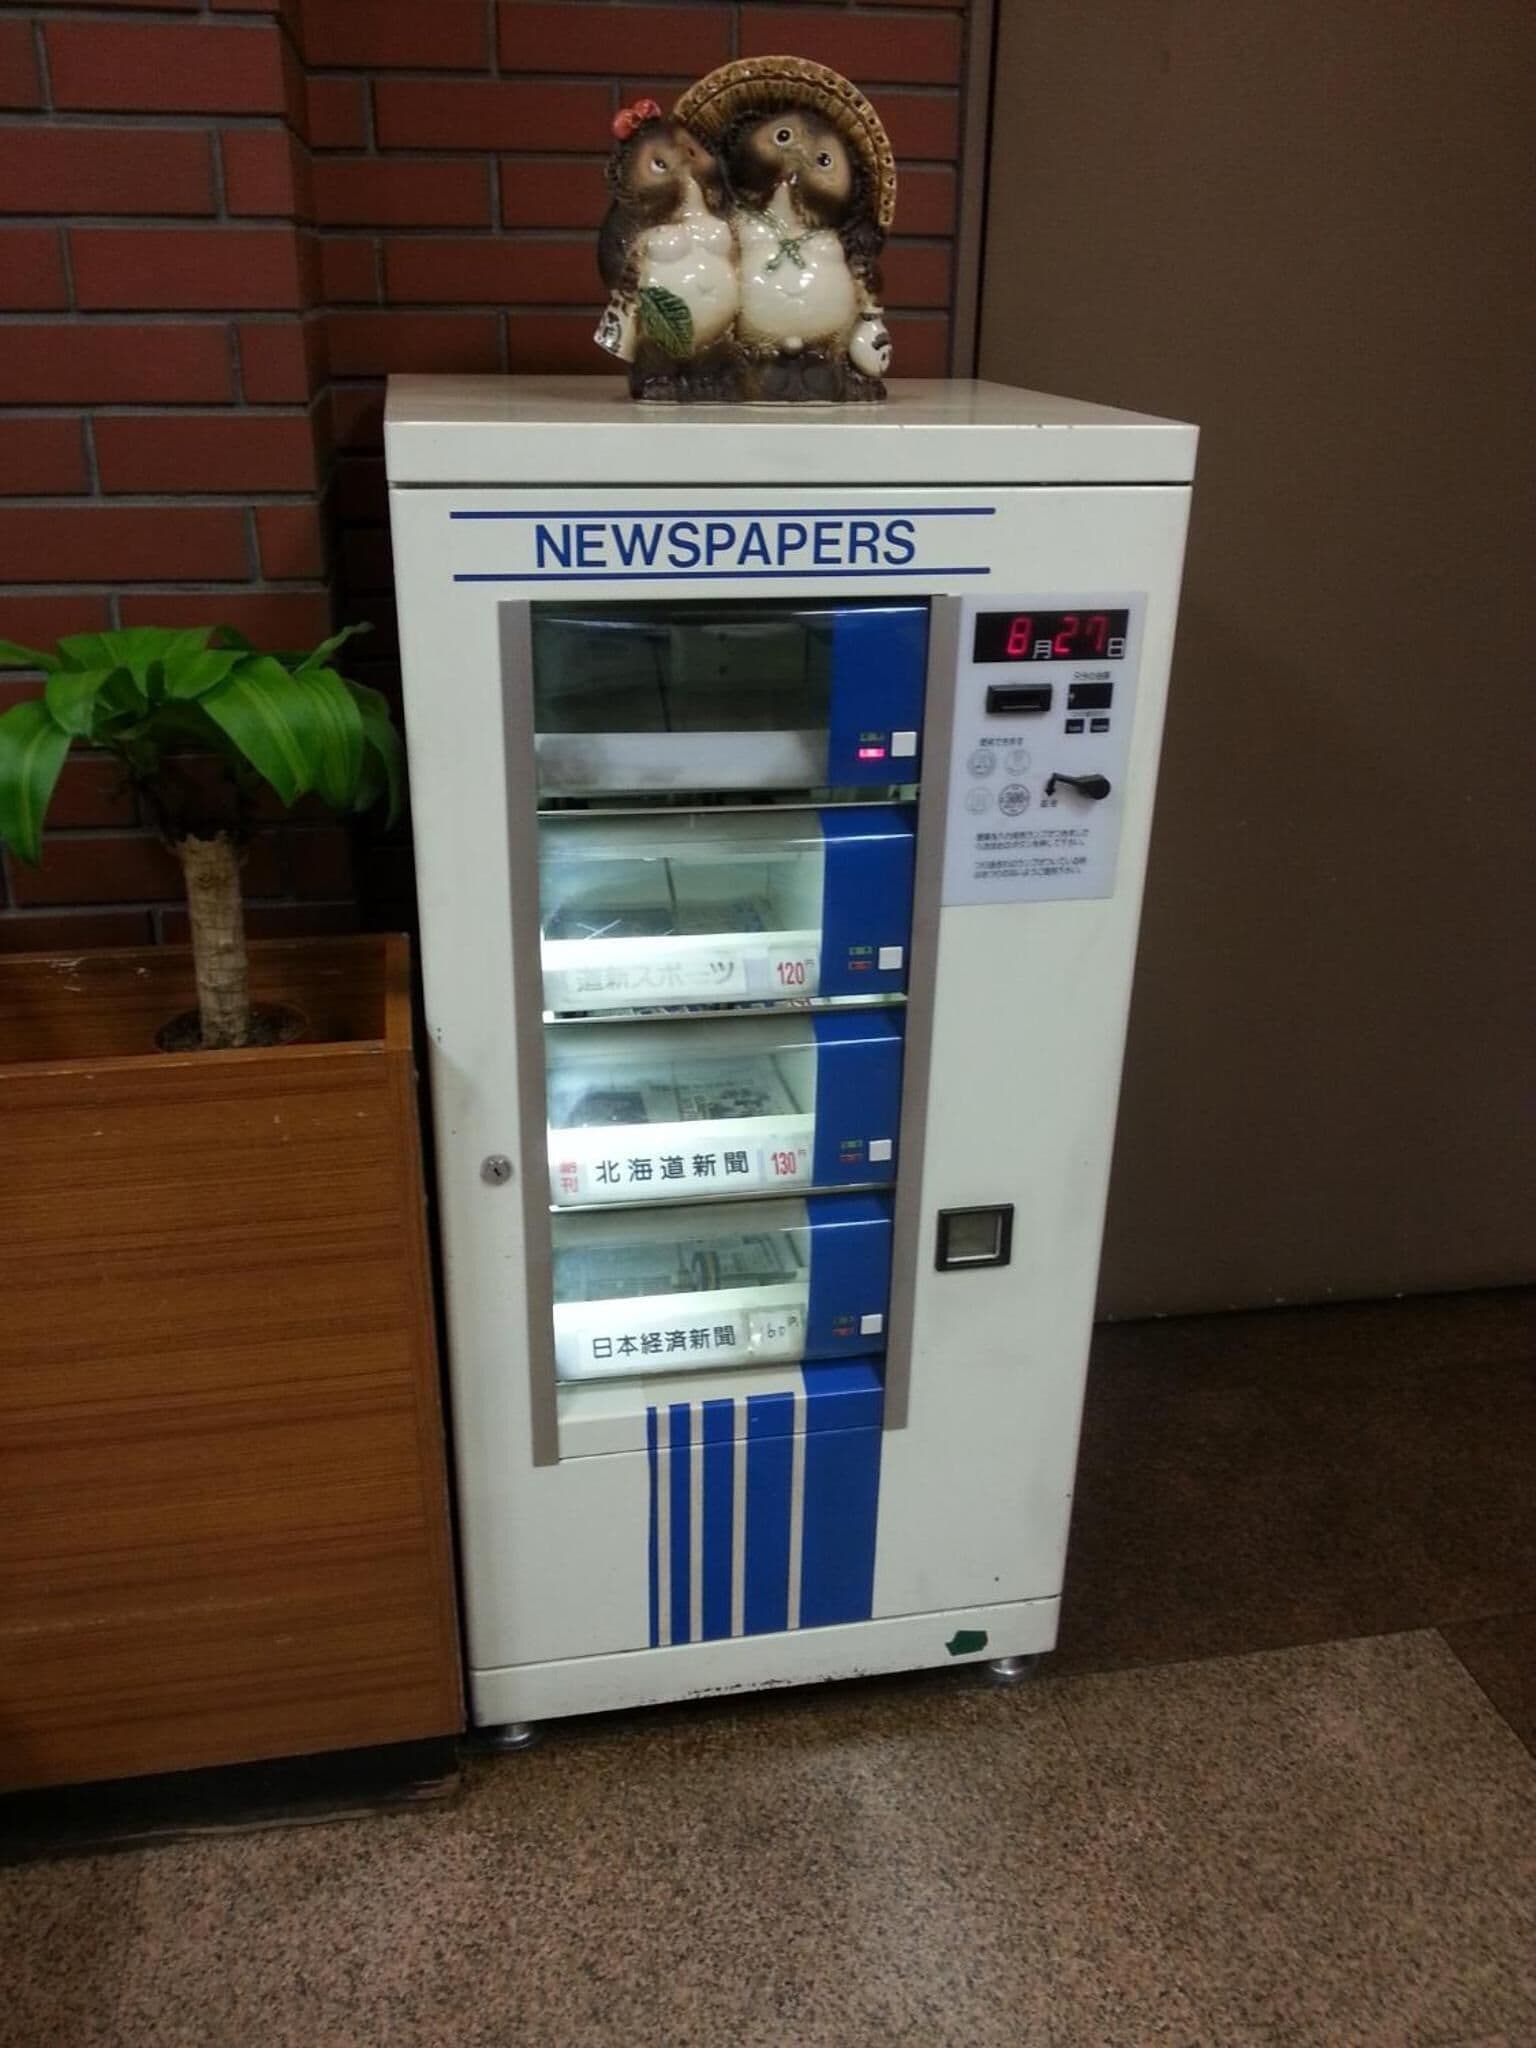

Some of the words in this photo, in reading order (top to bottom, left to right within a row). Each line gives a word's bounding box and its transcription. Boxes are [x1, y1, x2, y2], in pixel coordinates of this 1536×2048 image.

[535, 519, 917, 569] NEWSPAPERS
[595, 1150, 750, 1185] 北海道新聞
[592, 1324, 737, 1359] 日本経済新聞
